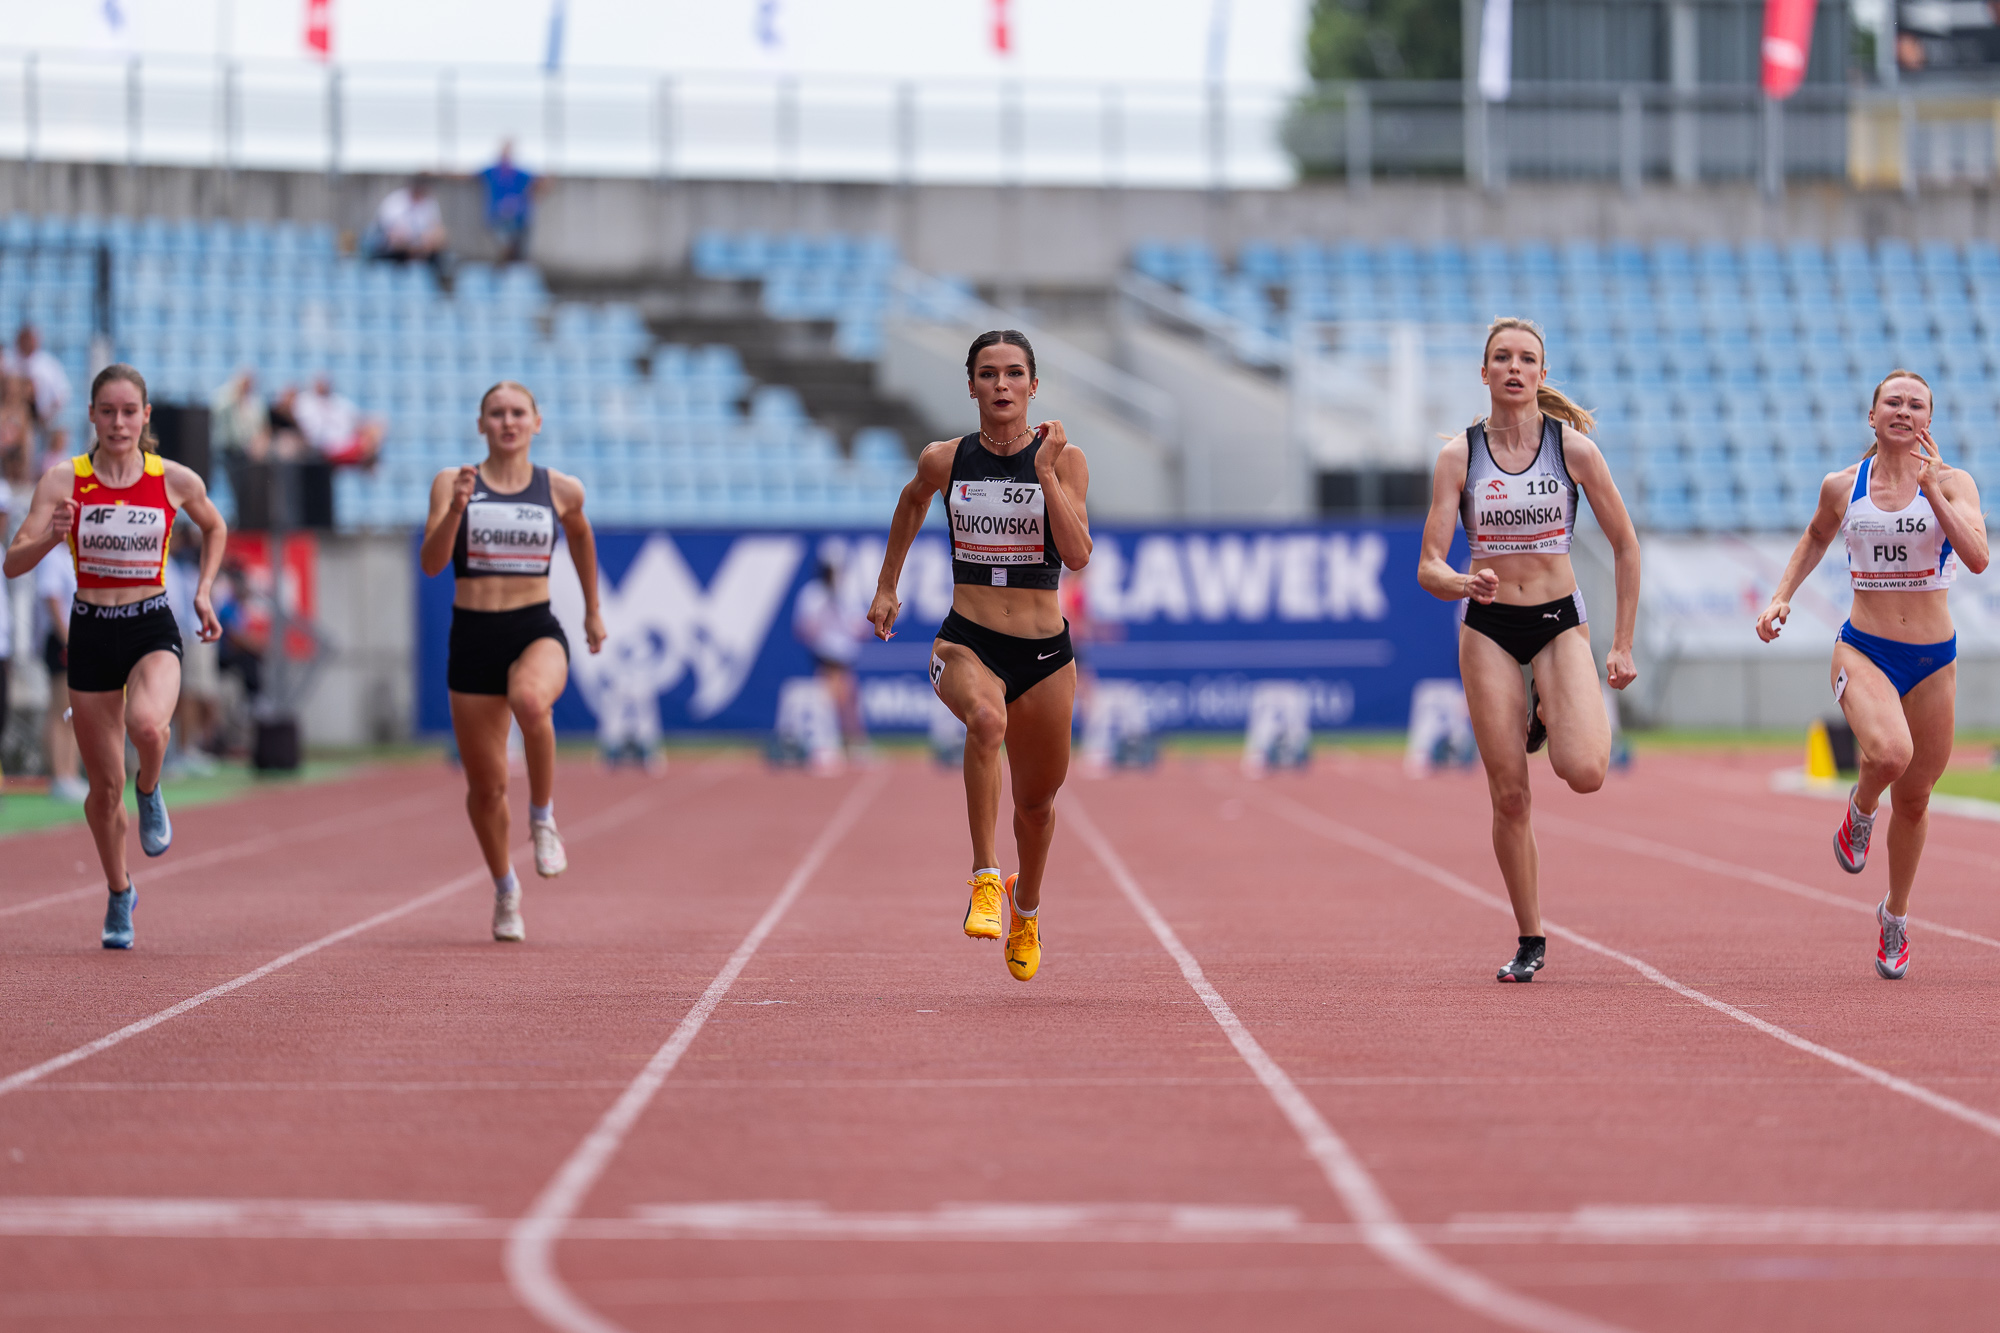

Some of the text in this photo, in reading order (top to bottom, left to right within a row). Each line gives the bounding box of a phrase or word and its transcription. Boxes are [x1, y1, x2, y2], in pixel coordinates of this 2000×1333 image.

[1002, 487, 1036, 504] 567
[1527, 480, 1558, 496] 110
[85, 507, 116, 524] 4F
[127, 510, 157, 525] 229
[953, 509, 1040, 535] ŻUKOWSKA
[1480, 504, 1562, 526] JAROSIŃSKA
[1895, 517, 1927, 533] 156
[82, 531, 158, 551] ŁAGODZIŃSKA
[471, 528, 549, 547] SOBIERAJ
[1487, 539, 1558, 551] WŁOCŁAWEK 2025
[962, 552, 1033, 562] WŁOCŁAWEK 2025
[1873, 545, 1908, 562] FUS
[1857, 579, 1928, 588] WŁOCŁAWEK 2025
[95, 602, 140, 619] NIKE
